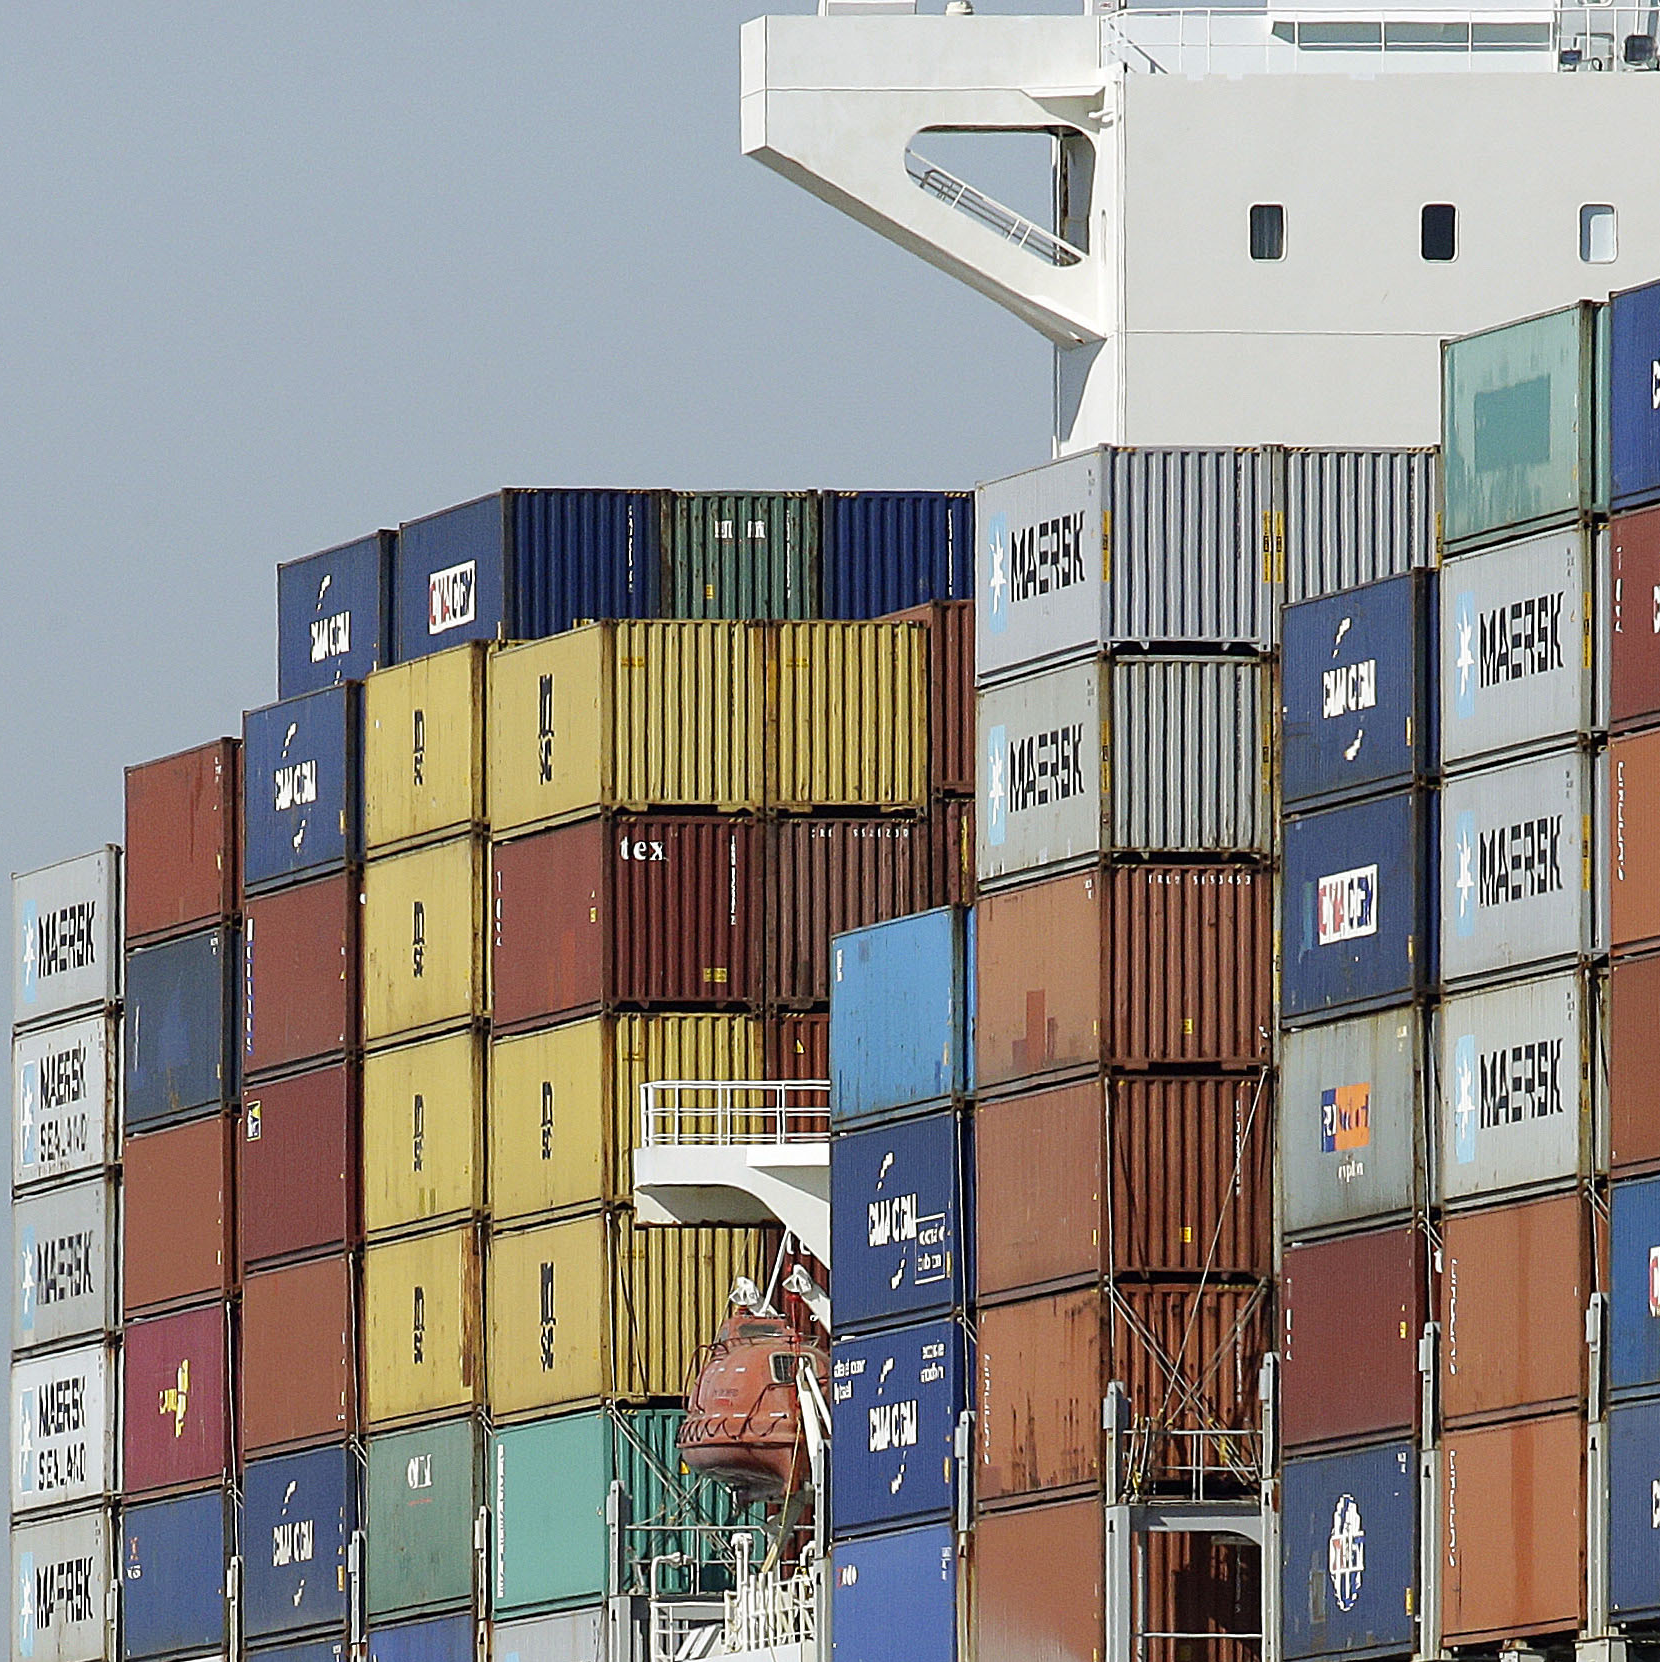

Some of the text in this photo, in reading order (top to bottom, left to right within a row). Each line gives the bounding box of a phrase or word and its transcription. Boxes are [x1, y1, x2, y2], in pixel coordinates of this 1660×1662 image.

[1010, 509, 1086, 602] MAERSK
[1479, 591, 1564, 688] MAERSK
[1009, 723, 1085, 812] MAERSK
[620, 837, 667, 862] tex
[1478, 815, 1564, 908] MAERSK
[38, 901, 96, 978] MAERSK
[39, 1038, 87, 1108] MAERSK
[1479, 1037, 1564, 1130] MAERSK
[37, 1231, 93, 1303] MAERSK
[38, 1376, 86, 1438] MAERSK
[35, 1556, 93, 1628] MAERSK
